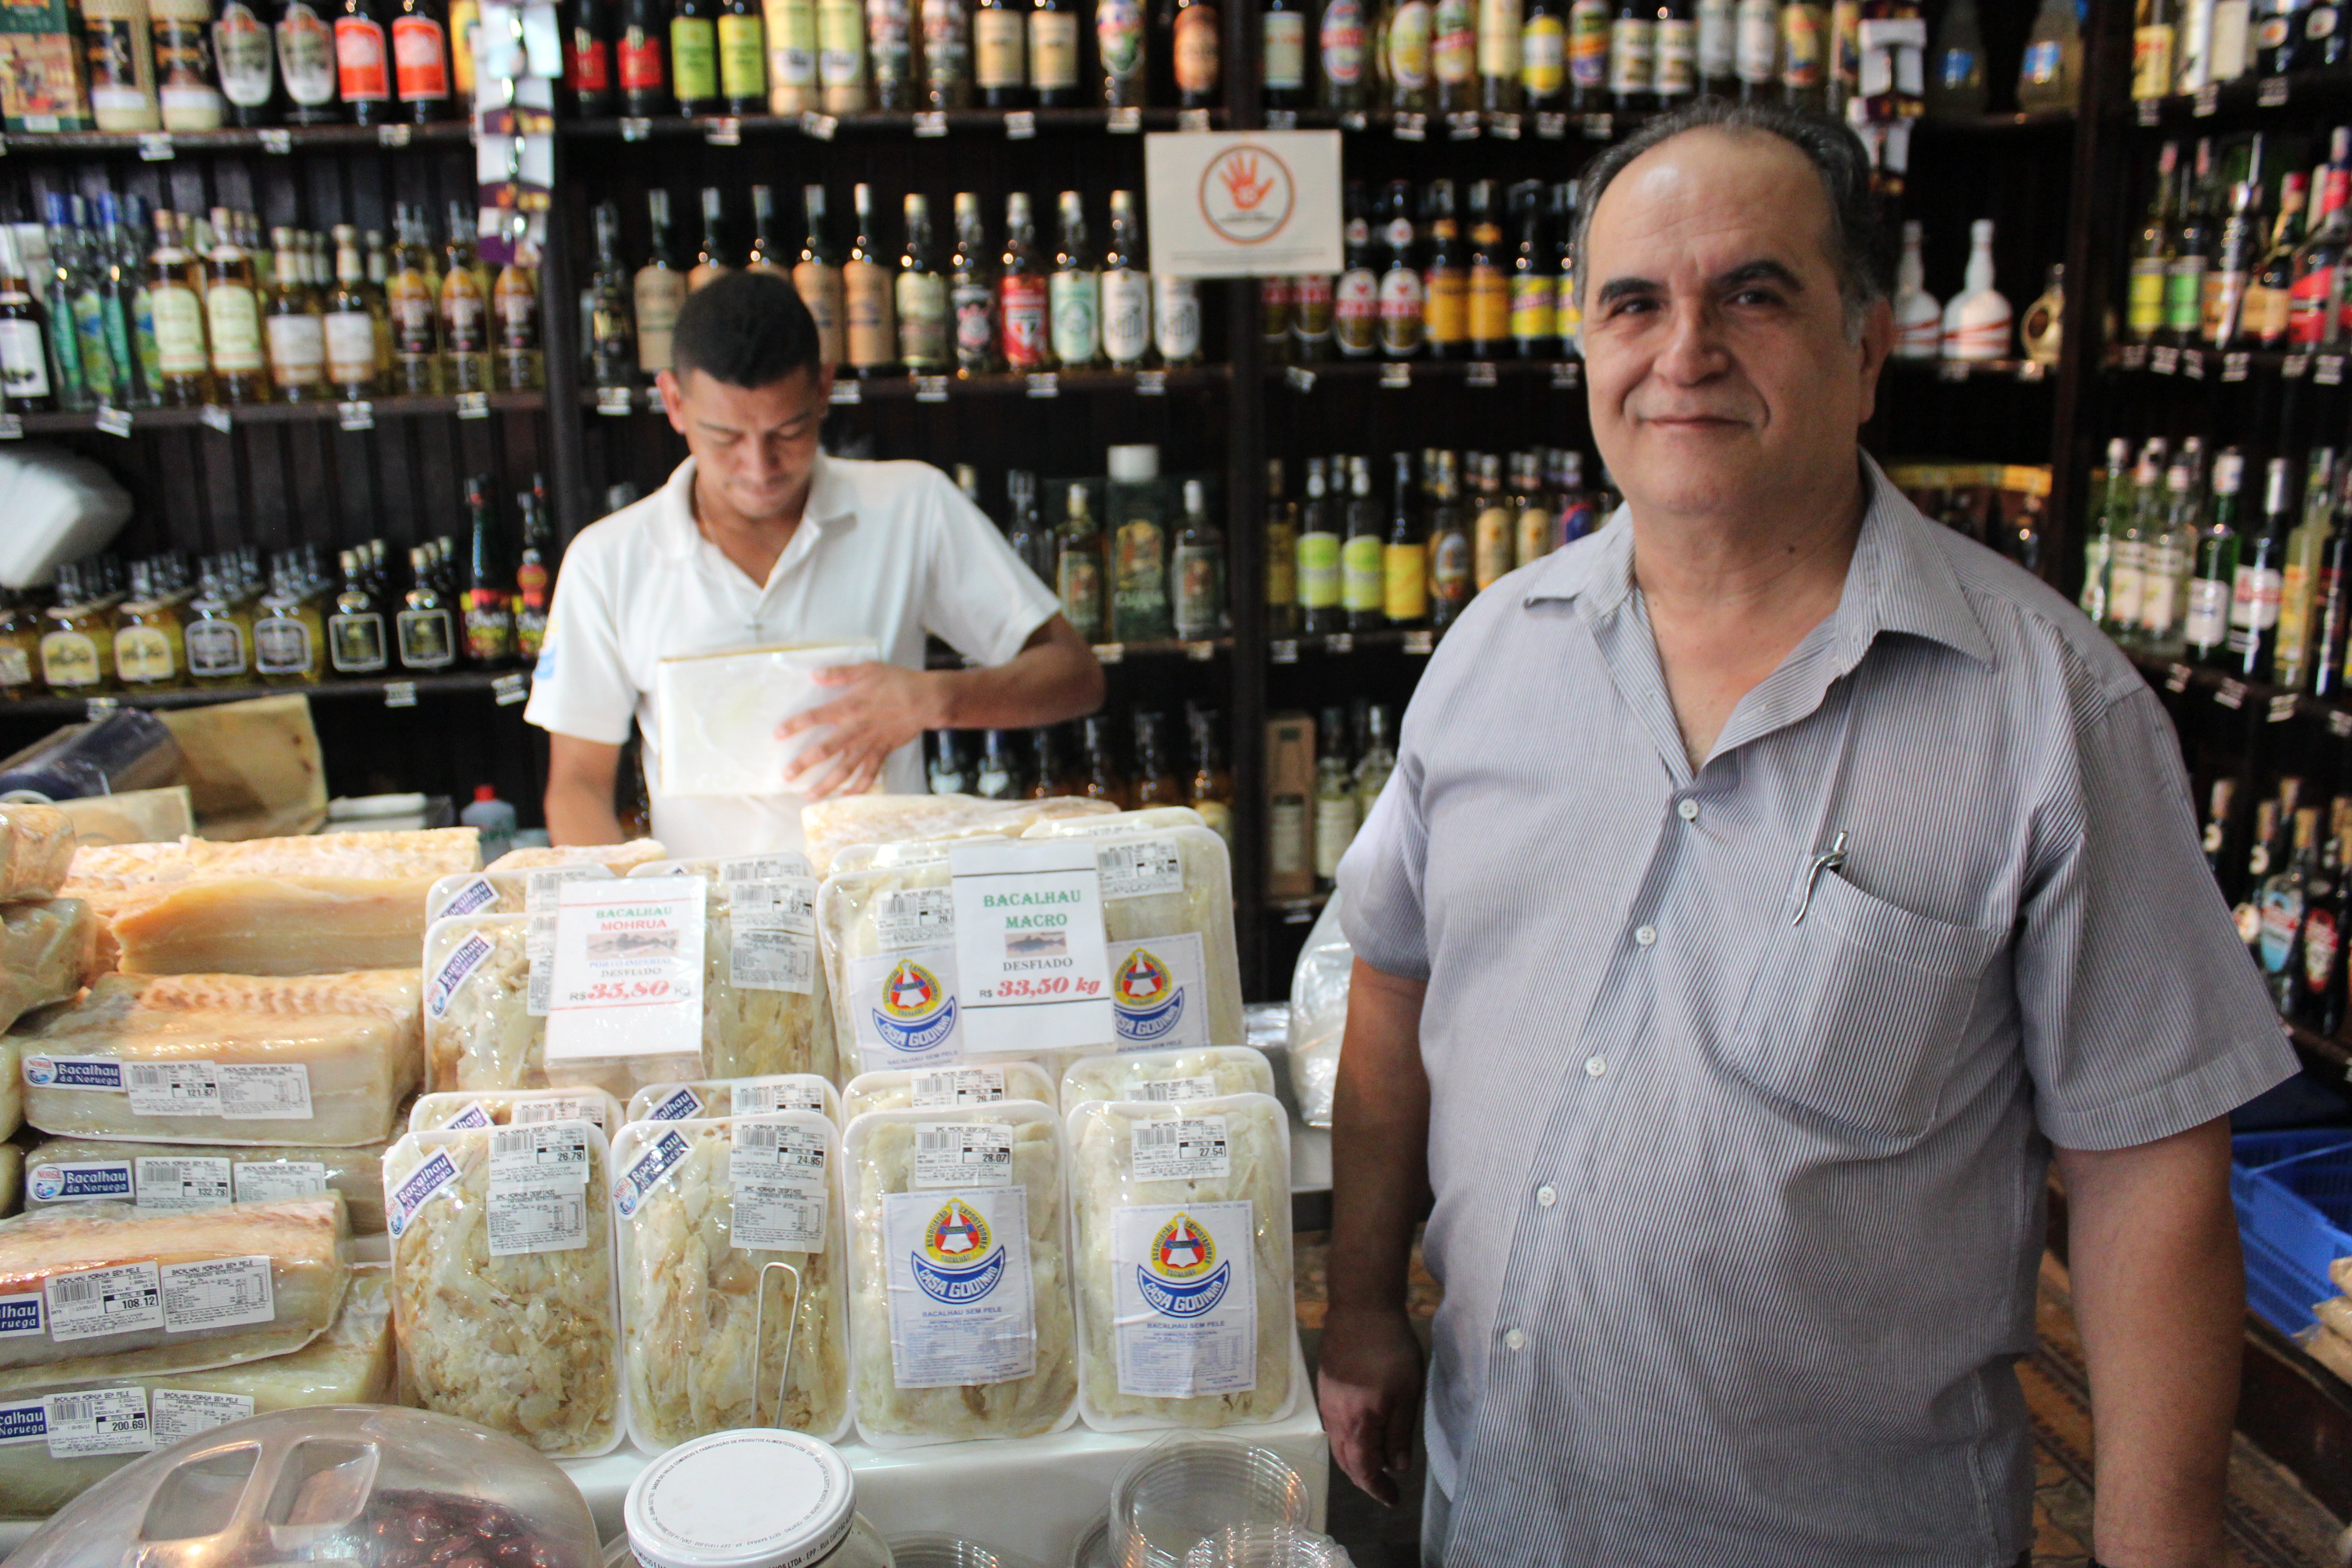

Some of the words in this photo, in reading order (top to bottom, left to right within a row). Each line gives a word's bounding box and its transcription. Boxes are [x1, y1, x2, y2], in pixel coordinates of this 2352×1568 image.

[983, 890, 1081, 907] BACALHAU
[596, 906, 672, 918] BACALHAU
[601, 919, 667, 931] MOHRUA
[1006, 914, 1068, 928] MACRO
[440, 938, 481, 981] Bacalhau
[624, 958, 671, 966] IMPERIAL
[1003, 958, 1073, 971] DESFIADO
[602, 968, 662, 977] DESFIADO
[997, 976, 1069, 998] 33,50
[1075, 976, 1101, 995] kg
[880, 1023, 907, 1046] CASA
[908, 1015, 951, 1047] GODINHO
[59, 1064, 118, 1076] Bacalhau
[75, 1076, 118, 1085] Noruega
[66, 1171, 127, 1183] Bacalhau
[399, 1158, 448, 1203] Bacalhau
[67, 1185, 80, 1193] da
[83, 1183, 127, 1192] Noruega
[407, 1198, 416, 1210] da
[415, 1167, 452, 1200] Noruega
[614, 1178, 632, 1198] NORGE
[927, 1210, 948, 1247] ASSOCIAÇÃO
[959, 1206, 986, 1250] EXPORTADORES
[1152, 1224, 1174, 1261] ASSOCIAÇÃO
[1185, 1220, 1211, 1264] EXPORTADORES
[940, 1254, 971, 1263] BACALHAU
[172, 1266, 199, 1275] BACALHAU
[1166, 1268, 1196, 1278] BACALHAU
[57, 1275, 85, 1284] BACALHAU
[919, 1269, 947, 1296] CASA
[949, 1266, 999, 1298] GODINHO
[1145, 1282, 1173, 1309] CASA
[1174, 1280, 1222, 1312] GODINHO
[0, 1306, 36, 1318] lhau
[2, 1318, 36, 1328] ruega
[0, 1411, 43, 1425] calhau
[650, 1479, 662, 1490] SABOR
[662, 1465, 676, 1475] VALLE
[698, 1441, 729, 1452] FABRICAÇÃO
[746, 1536, 769, 1545] BARRAS
[788, 1557, 802, 1567] LTDA
[806, 1548, 816, 1559] EPP
[820, 1539, 829, 1550] RUA
